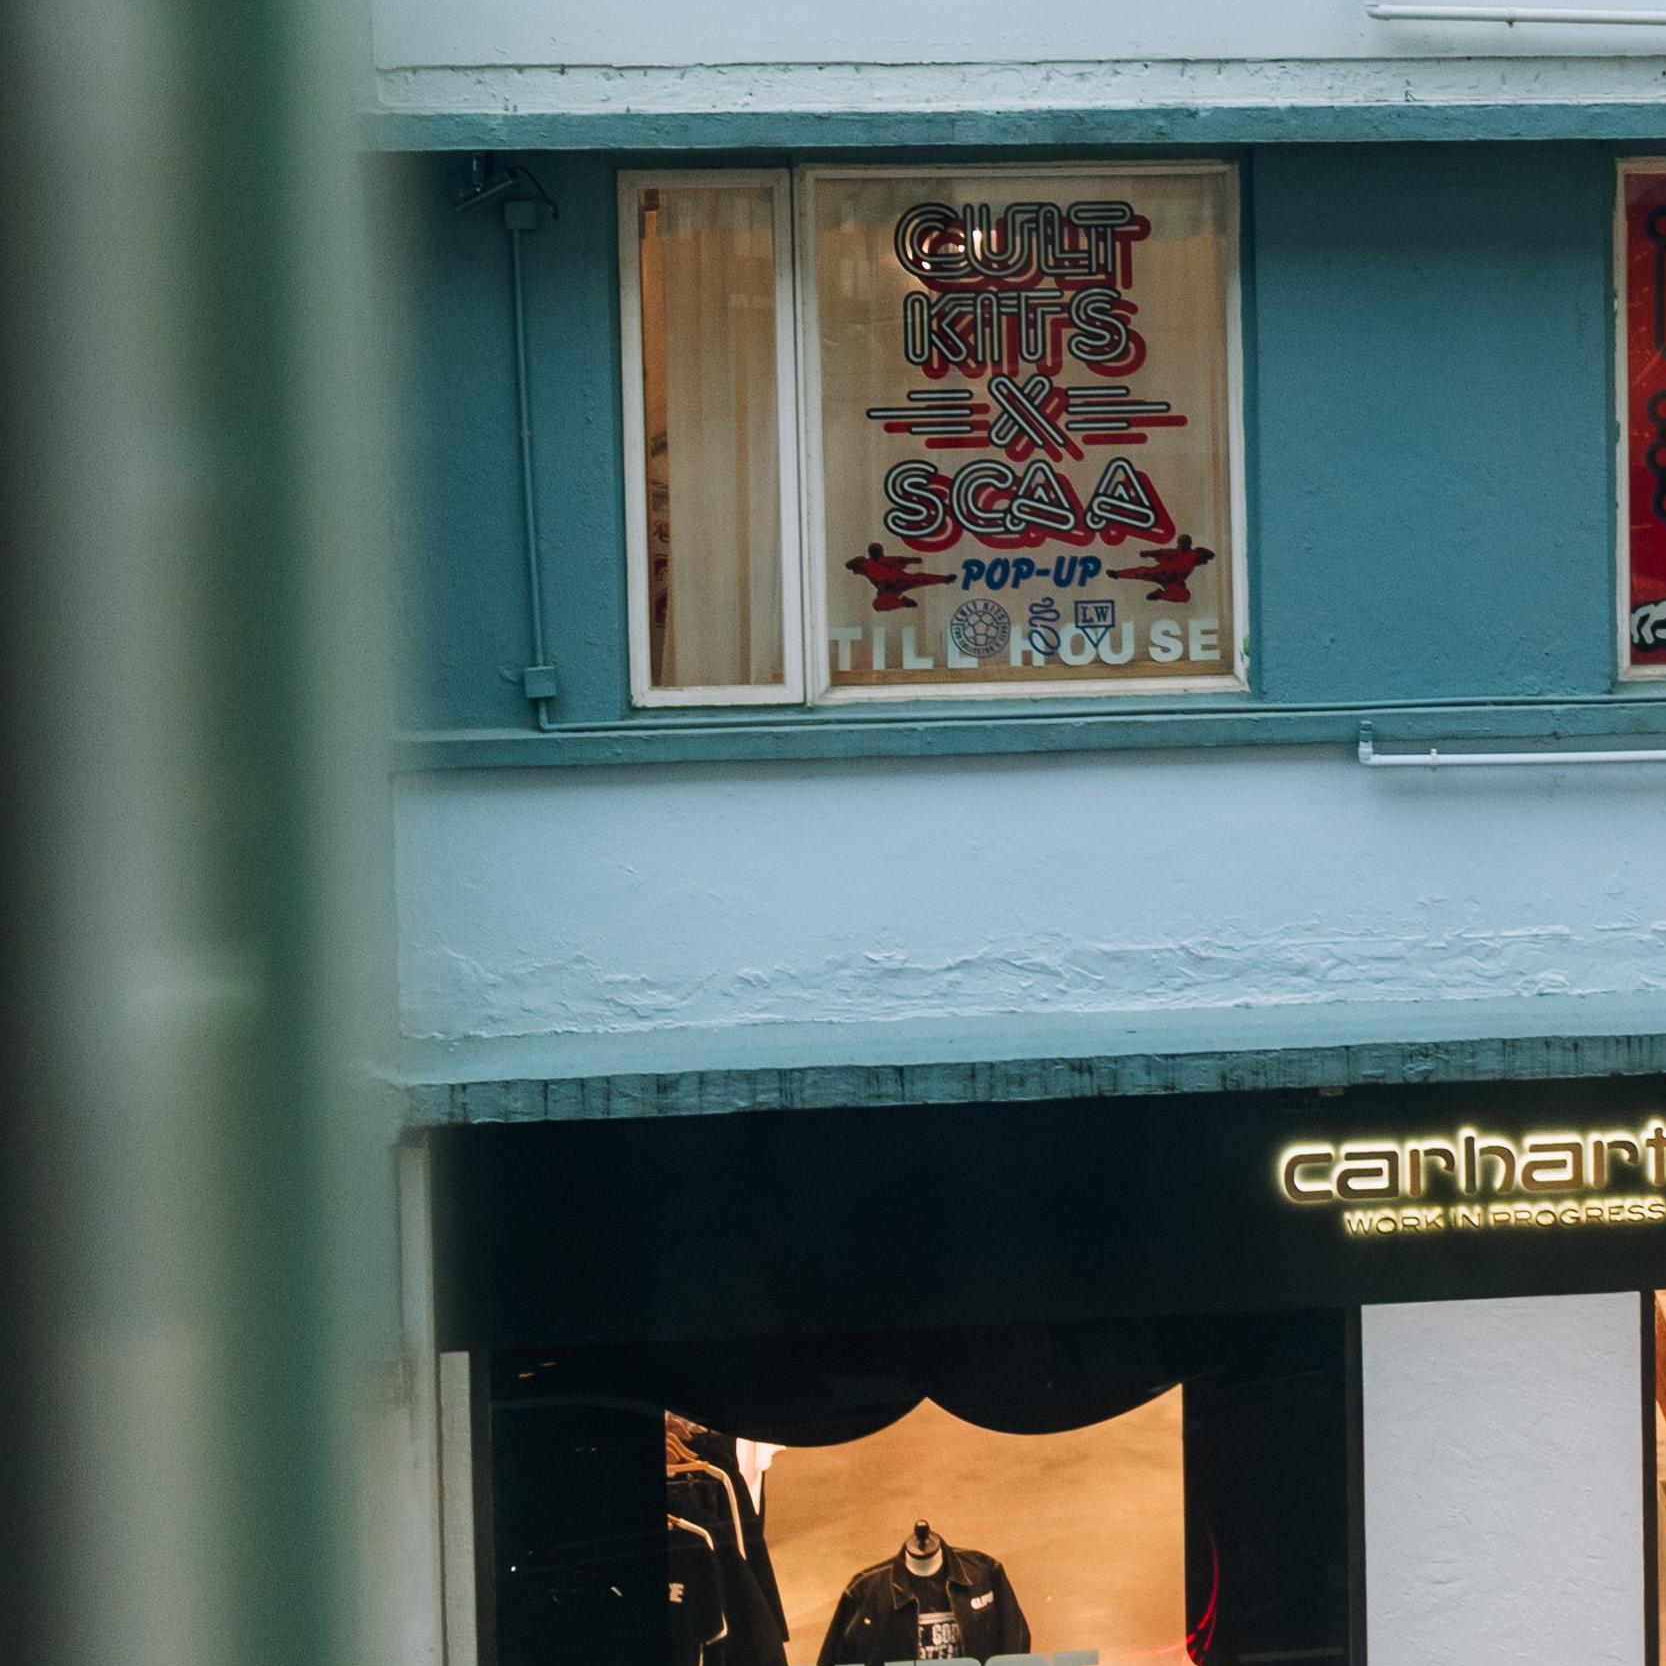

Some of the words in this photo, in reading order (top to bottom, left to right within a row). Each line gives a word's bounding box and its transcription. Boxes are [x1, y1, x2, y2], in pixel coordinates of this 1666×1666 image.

[894, 201, 1142, 285] CULT
[904, 287, 1138, 369] KITS
[987, 373, 1074, 455] X
[883, 457, 1165, 543] SCAA
[961, 556, 1102, 590] POP-UP
[1009, 617, 1222, 668] HOUSE
[1345, 1207, 1444, 1236] WORK
[1450, 1204, 1482, 1230] IN
